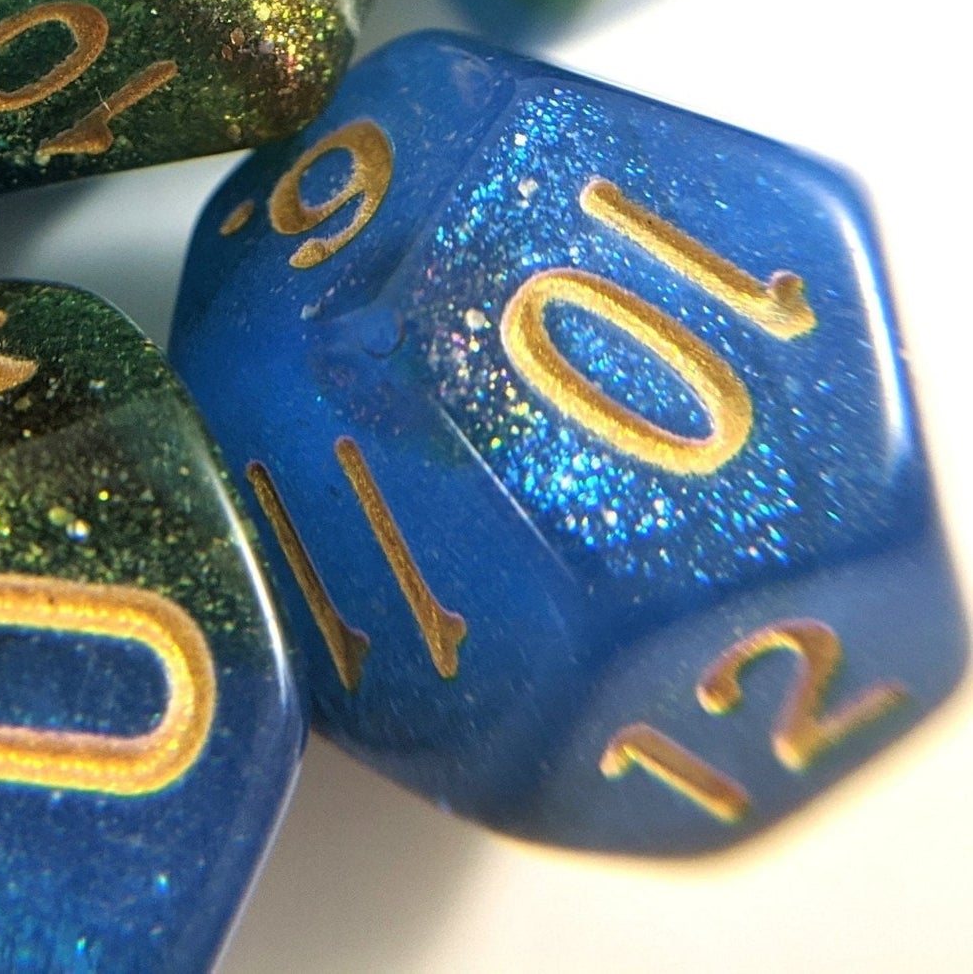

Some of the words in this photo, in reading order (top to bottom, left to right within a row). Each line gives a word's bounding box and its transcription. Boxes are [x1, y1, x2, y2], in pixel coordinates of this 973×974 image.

[501, 177, 816, 475] 10
[245, 436, 467, 692] 11
[599, 616, 910, 824] 12
